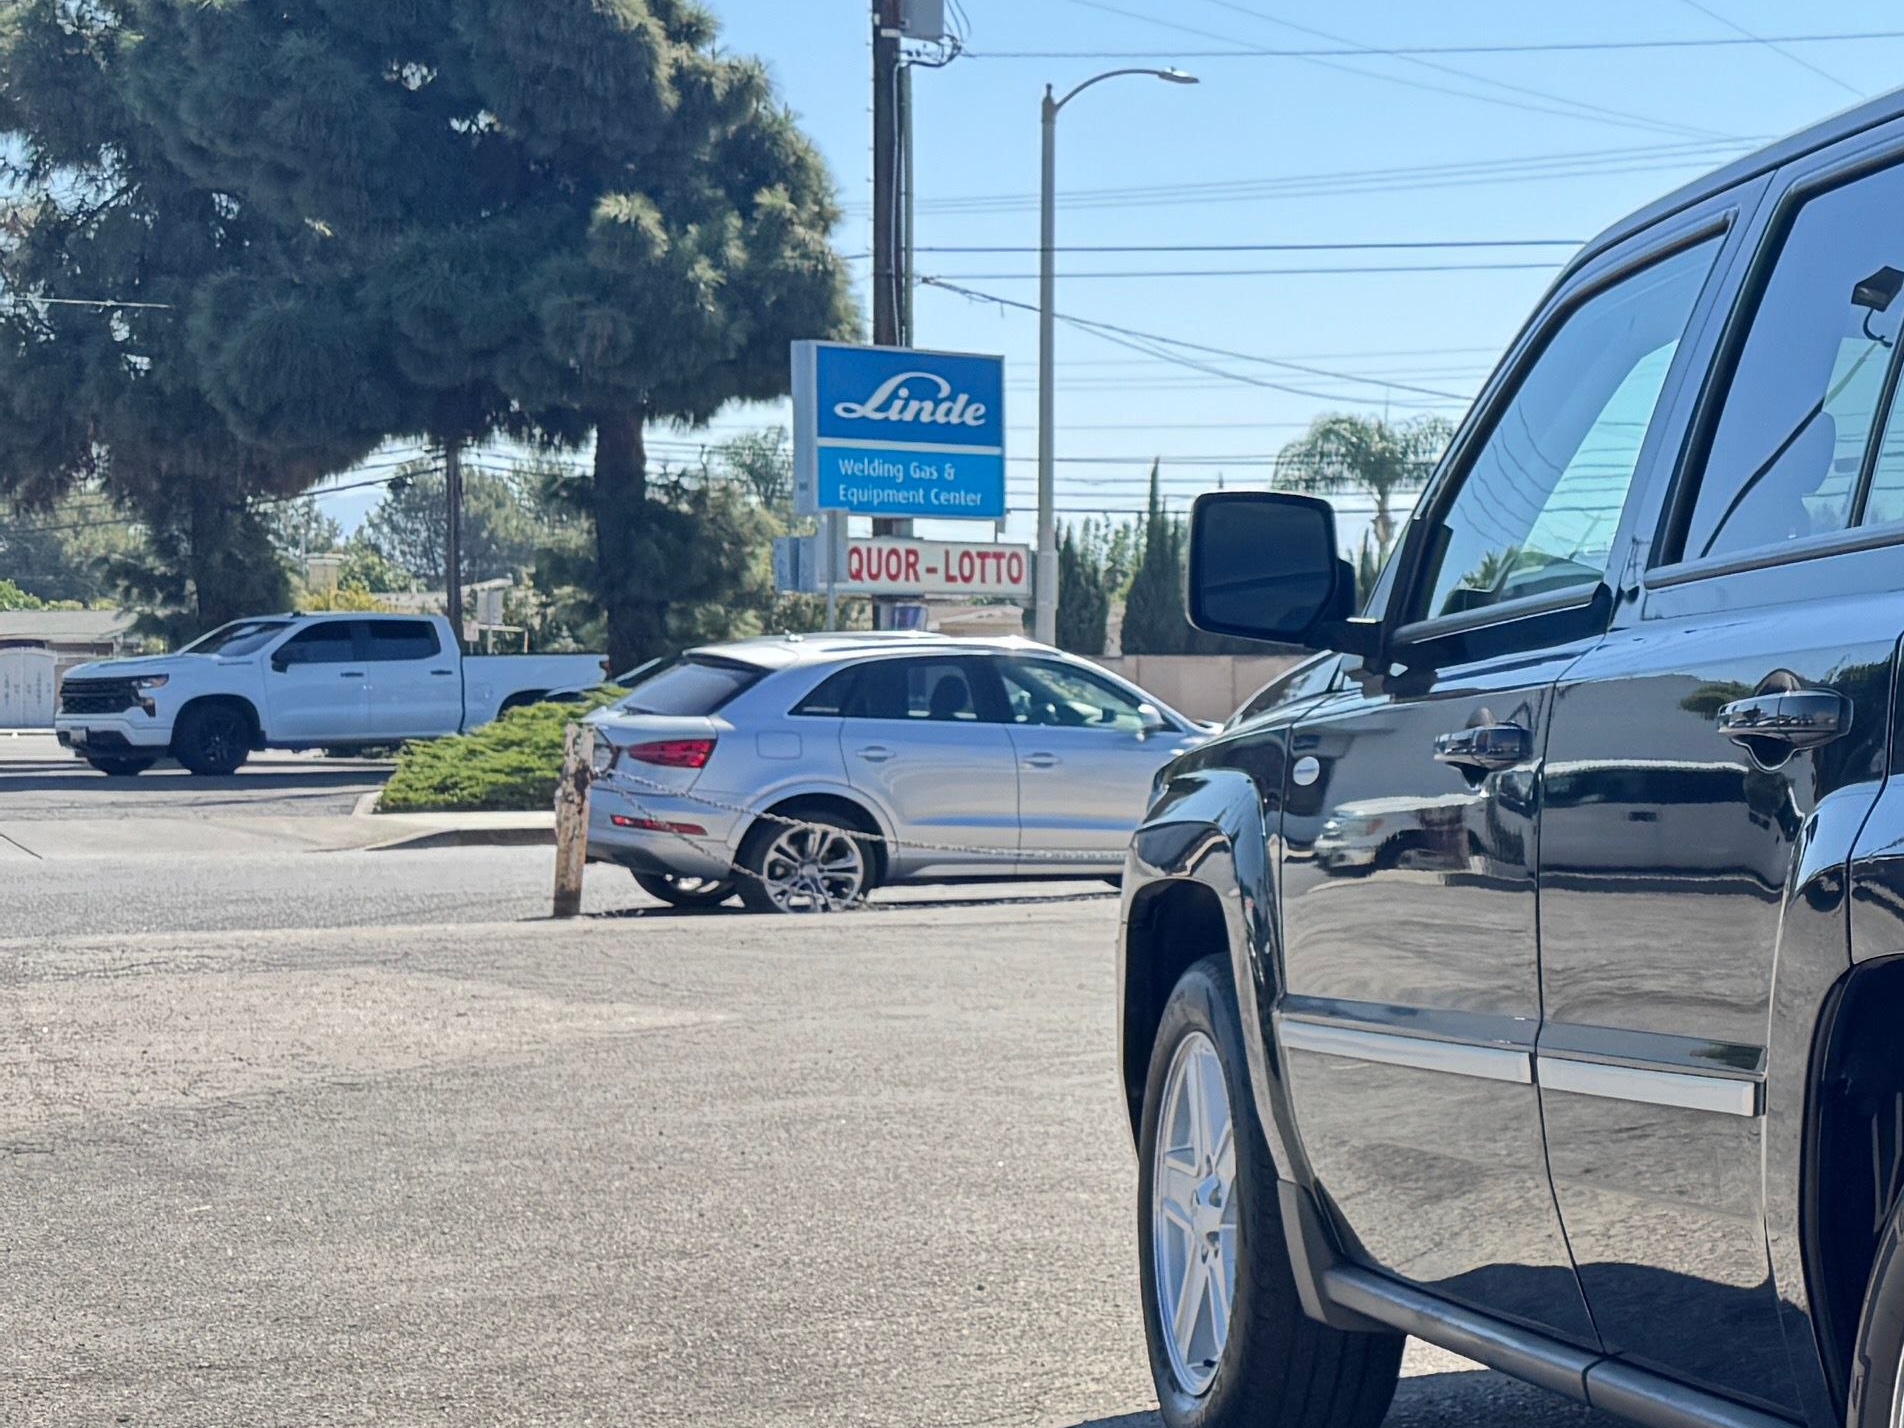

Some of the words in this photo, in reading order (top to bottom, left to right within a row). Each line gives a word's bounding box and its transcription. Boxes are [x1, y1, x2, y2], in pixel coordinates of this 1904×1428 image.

[834, 372, 986, 426] Linde
[839, 457, 903, 483] Welding
[910, 462, 938, 479] Gas
[944, 463, 955, 481] &
[839, 484, 924, 507] Equipment
[930, 488, 982, 506] Center
[944, 548, 1023, 585] LOTTO
